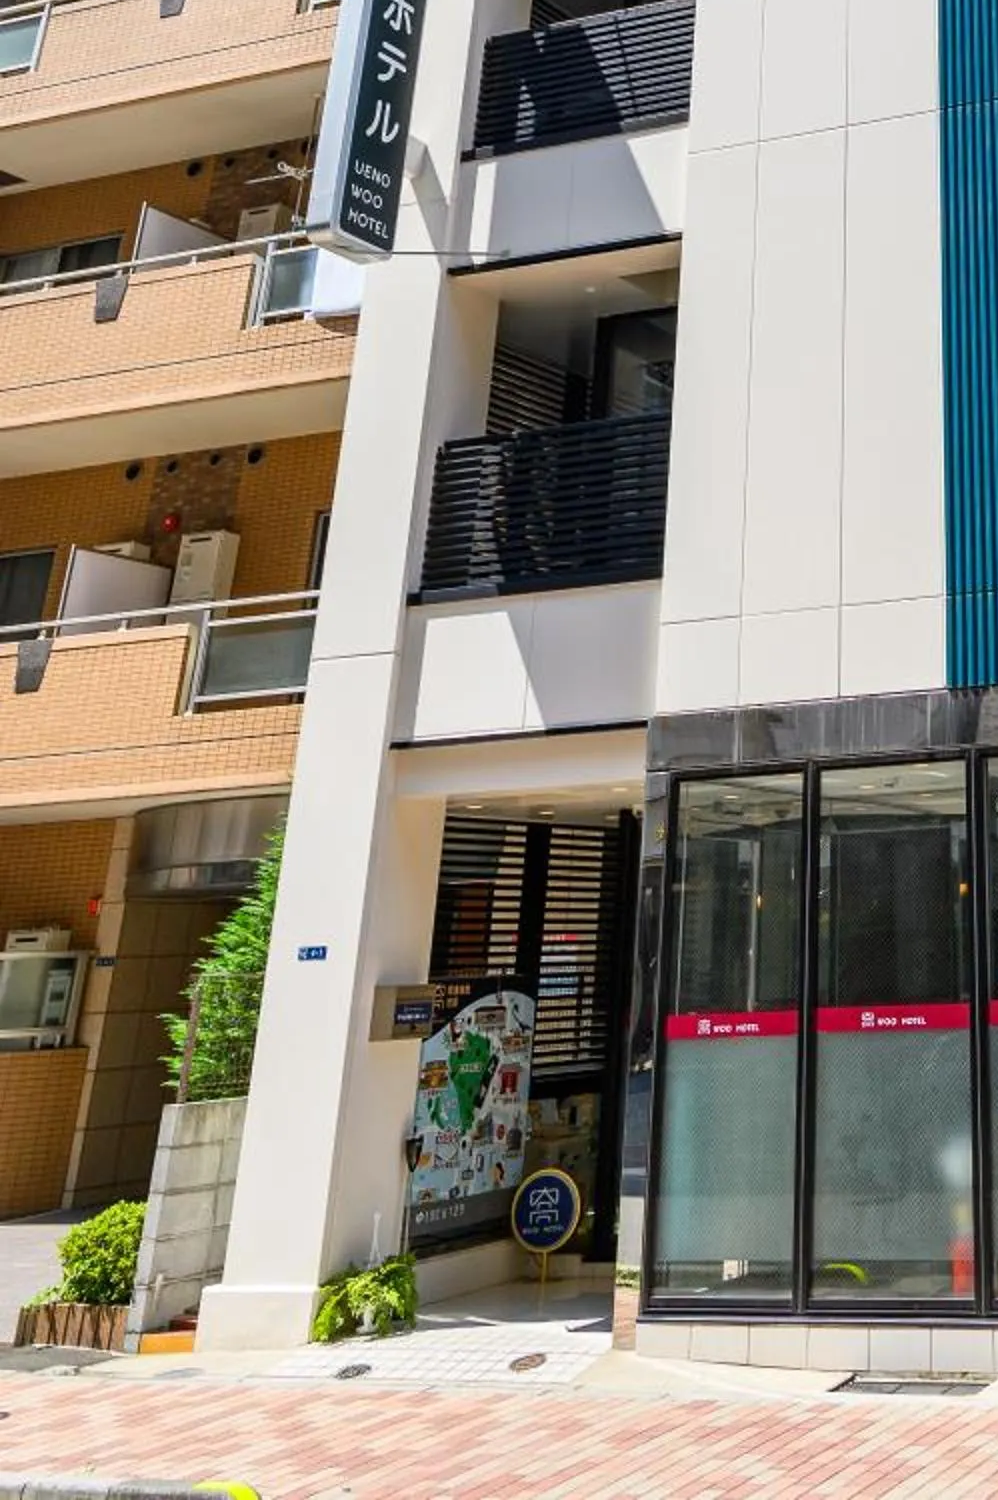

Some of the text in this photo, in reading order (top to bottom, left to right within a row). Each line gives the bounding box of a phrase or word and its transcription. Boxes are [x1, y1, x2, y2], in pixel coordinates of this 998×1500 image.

[354, 159, 391, 188] UENO
[351, 183, 383, 209] WOO
[347, 207, 390, 239] HOTEL
